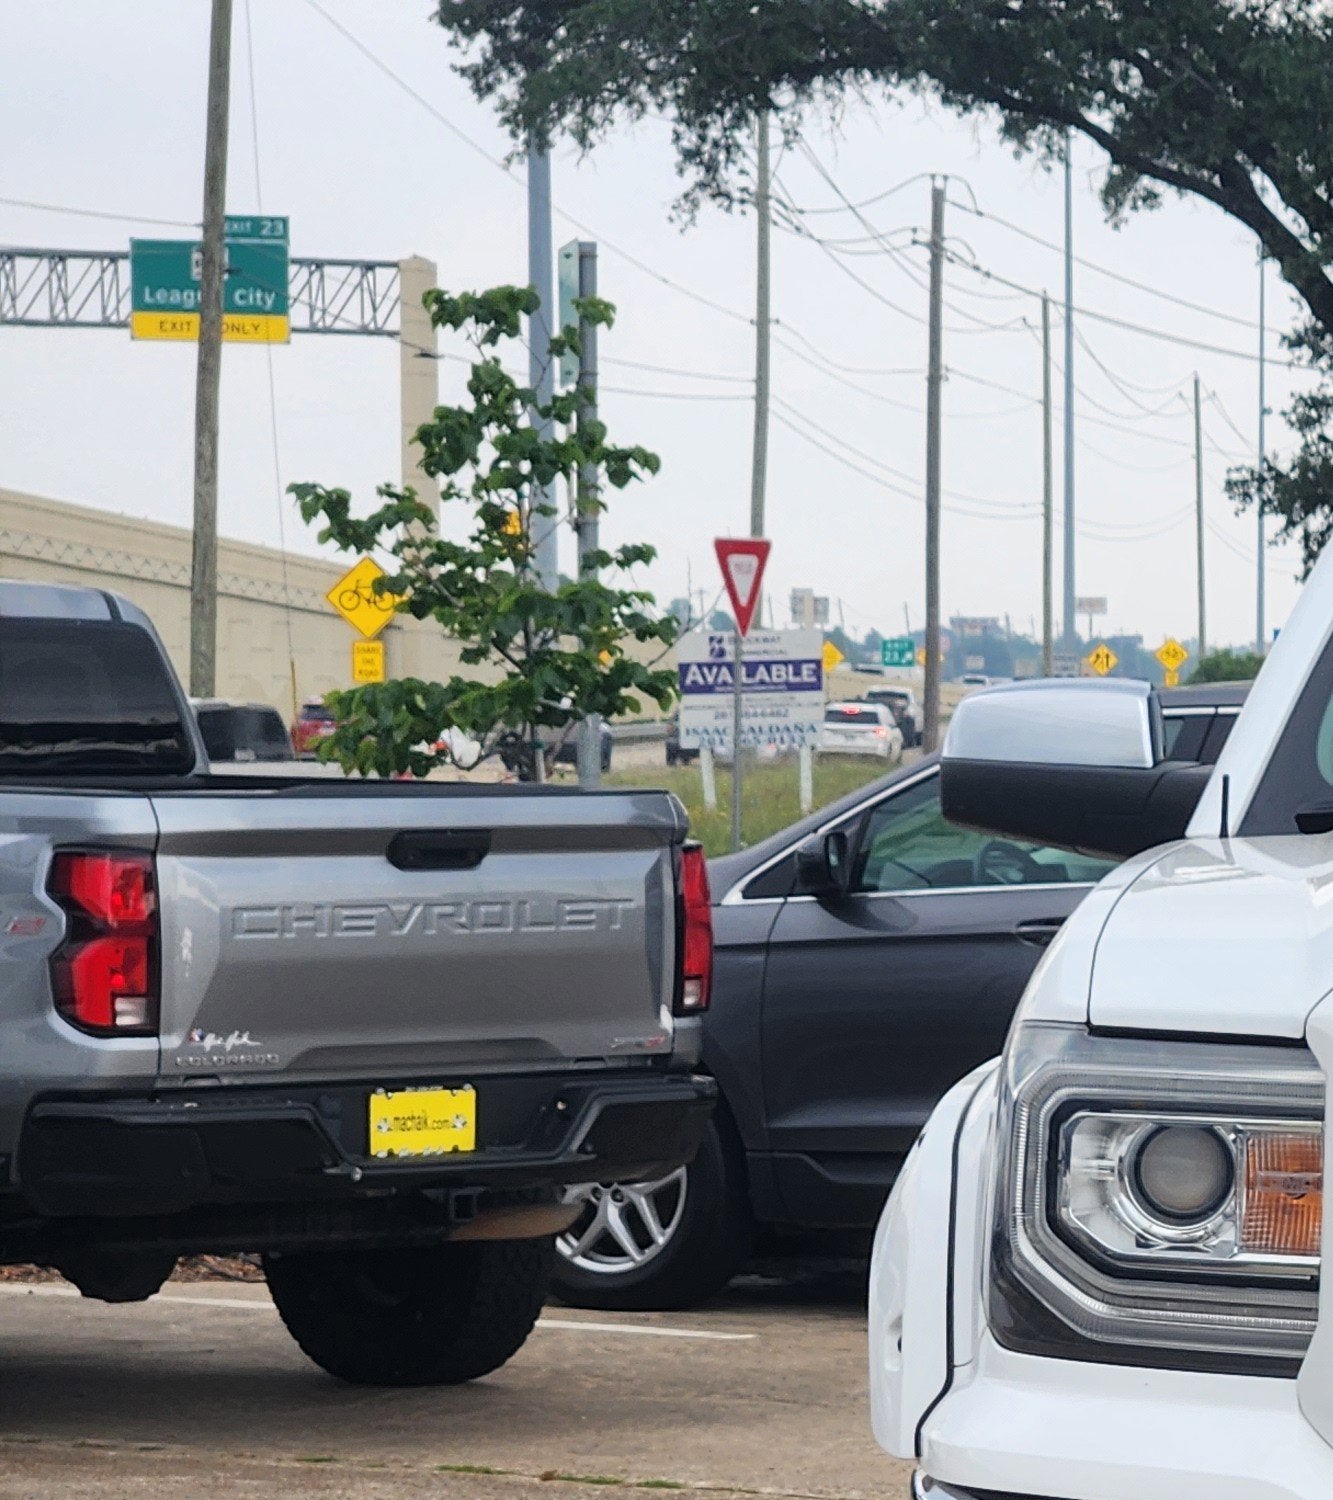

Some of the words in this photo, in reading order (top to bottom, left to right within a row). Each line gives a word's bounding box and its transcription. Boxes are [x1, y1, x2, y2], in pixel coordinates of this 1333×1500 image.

[260, 219, 285, 236] 23
[144, 286, 203, 309] Leag
[233, 287, 276, 311] City
[159, 320, 193, 333] EXIT
[685, 663, 818, 686] AVALABLE
[232, 898, 636, 939] CHEVROLET
[176, 1053, 280, 1067] COLORADO
